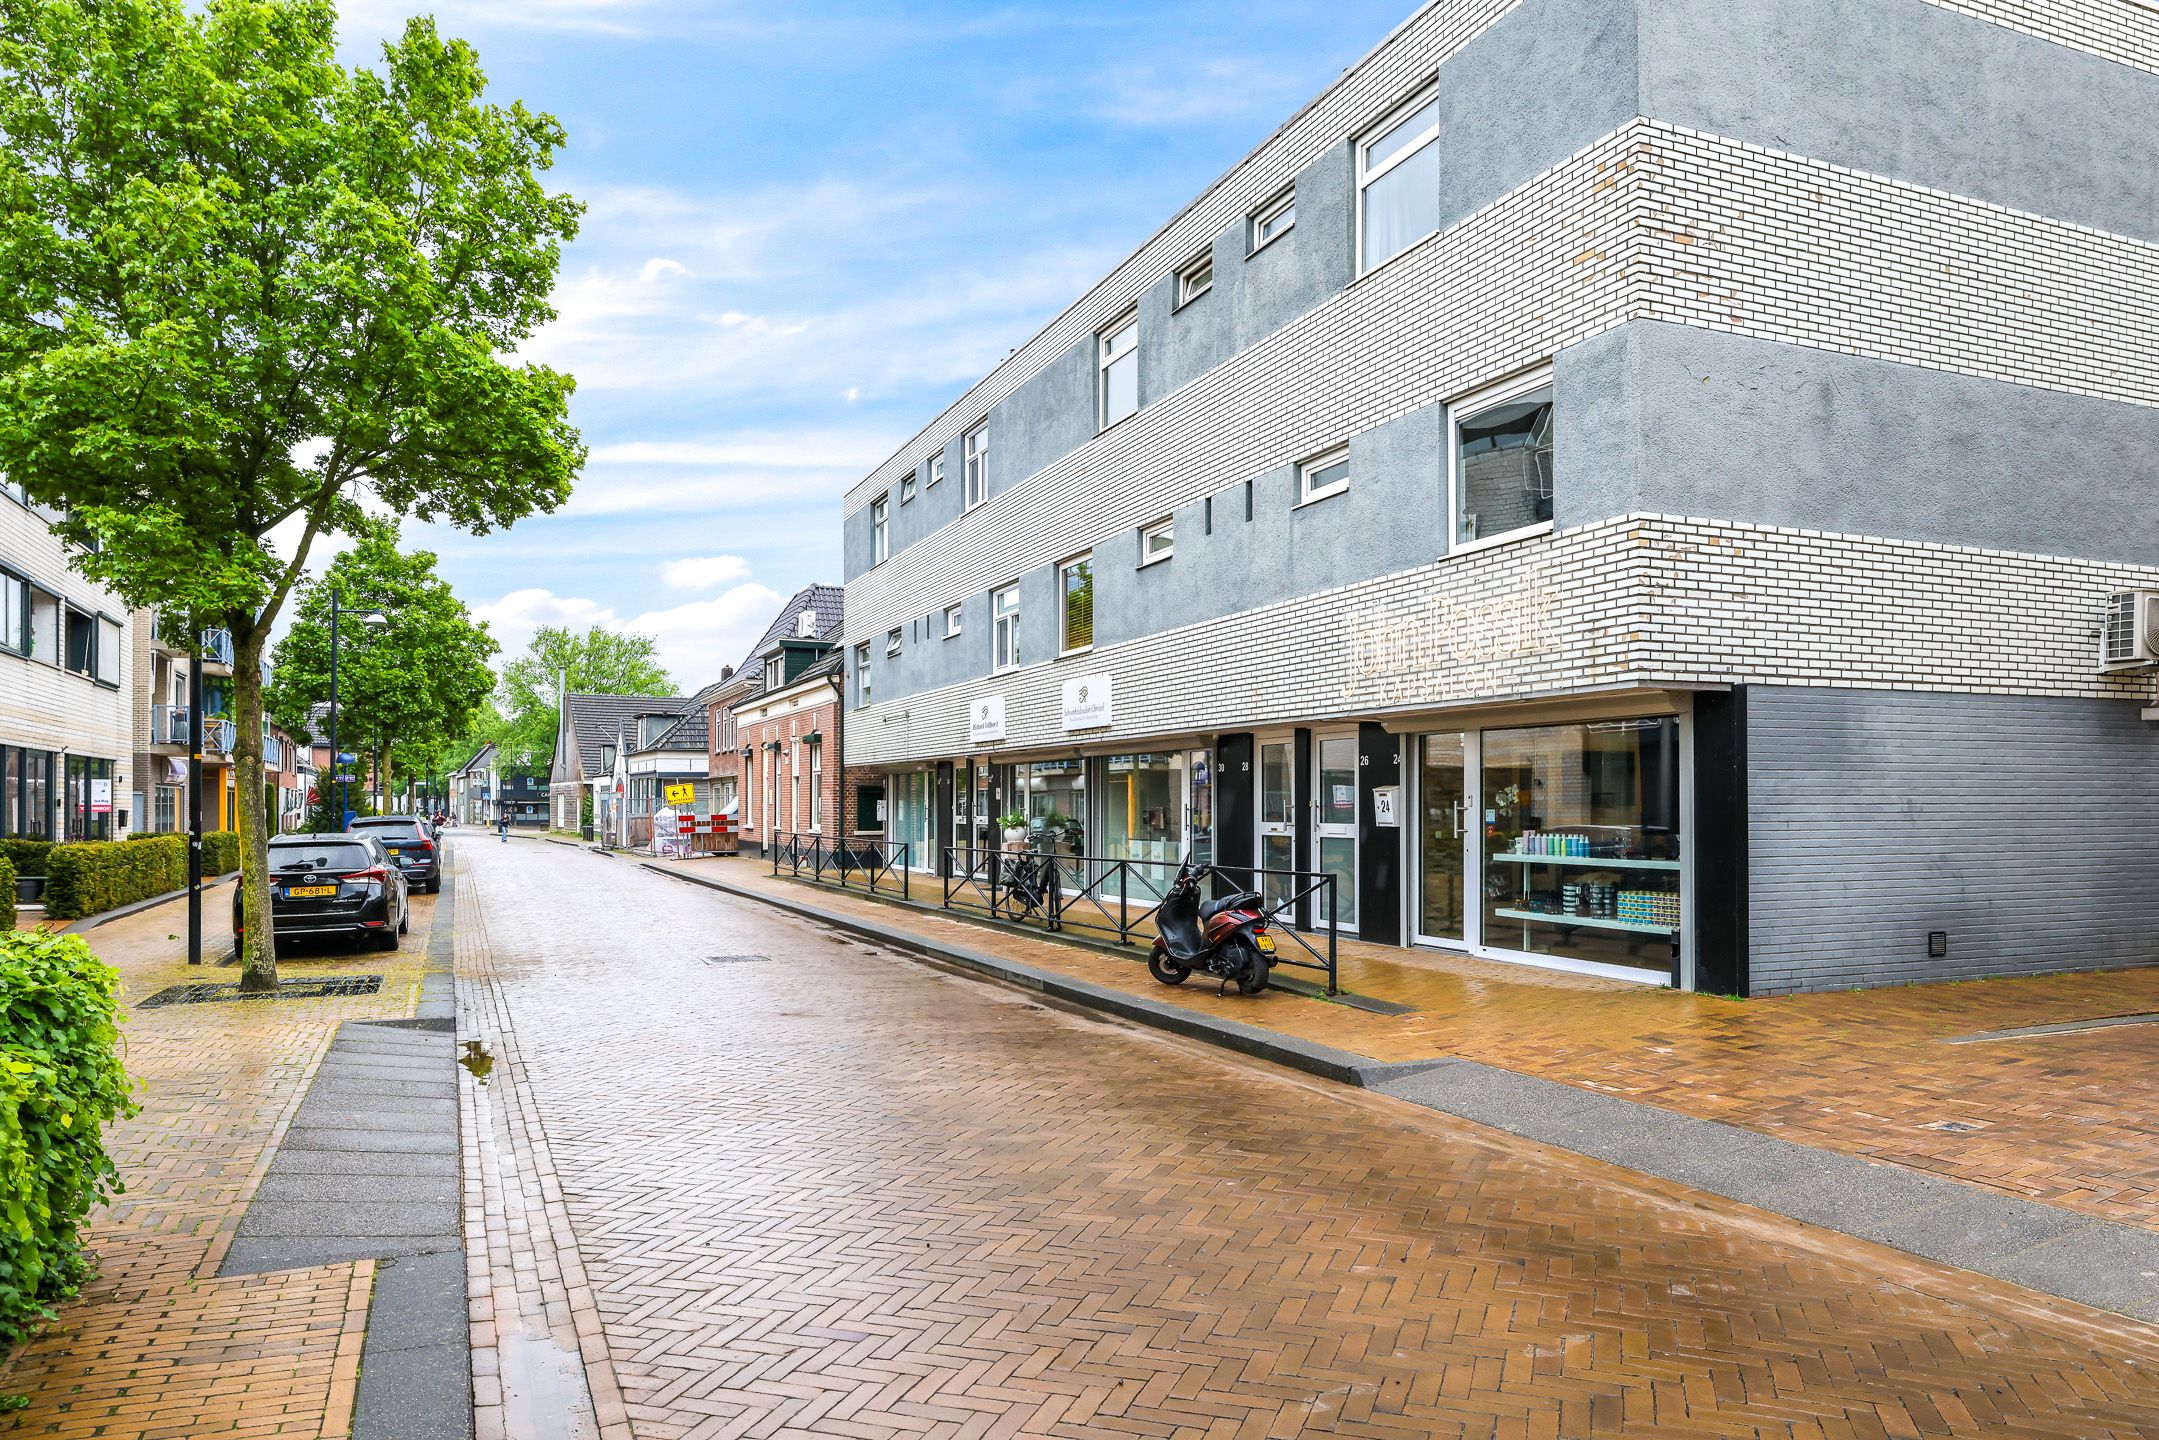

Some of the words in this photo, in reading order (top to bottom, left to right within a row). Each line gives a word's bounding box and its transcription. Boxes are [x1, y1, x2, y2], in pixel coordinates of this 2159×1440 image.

[1379, 667, 1497, 705] KAPSALON
[1241, 761, 1249, 771] 28
[1360, 755, 1369, 766] 26
[1217, 763, 1225, 773] 30
[1380, 799, 1390, 813] 24
